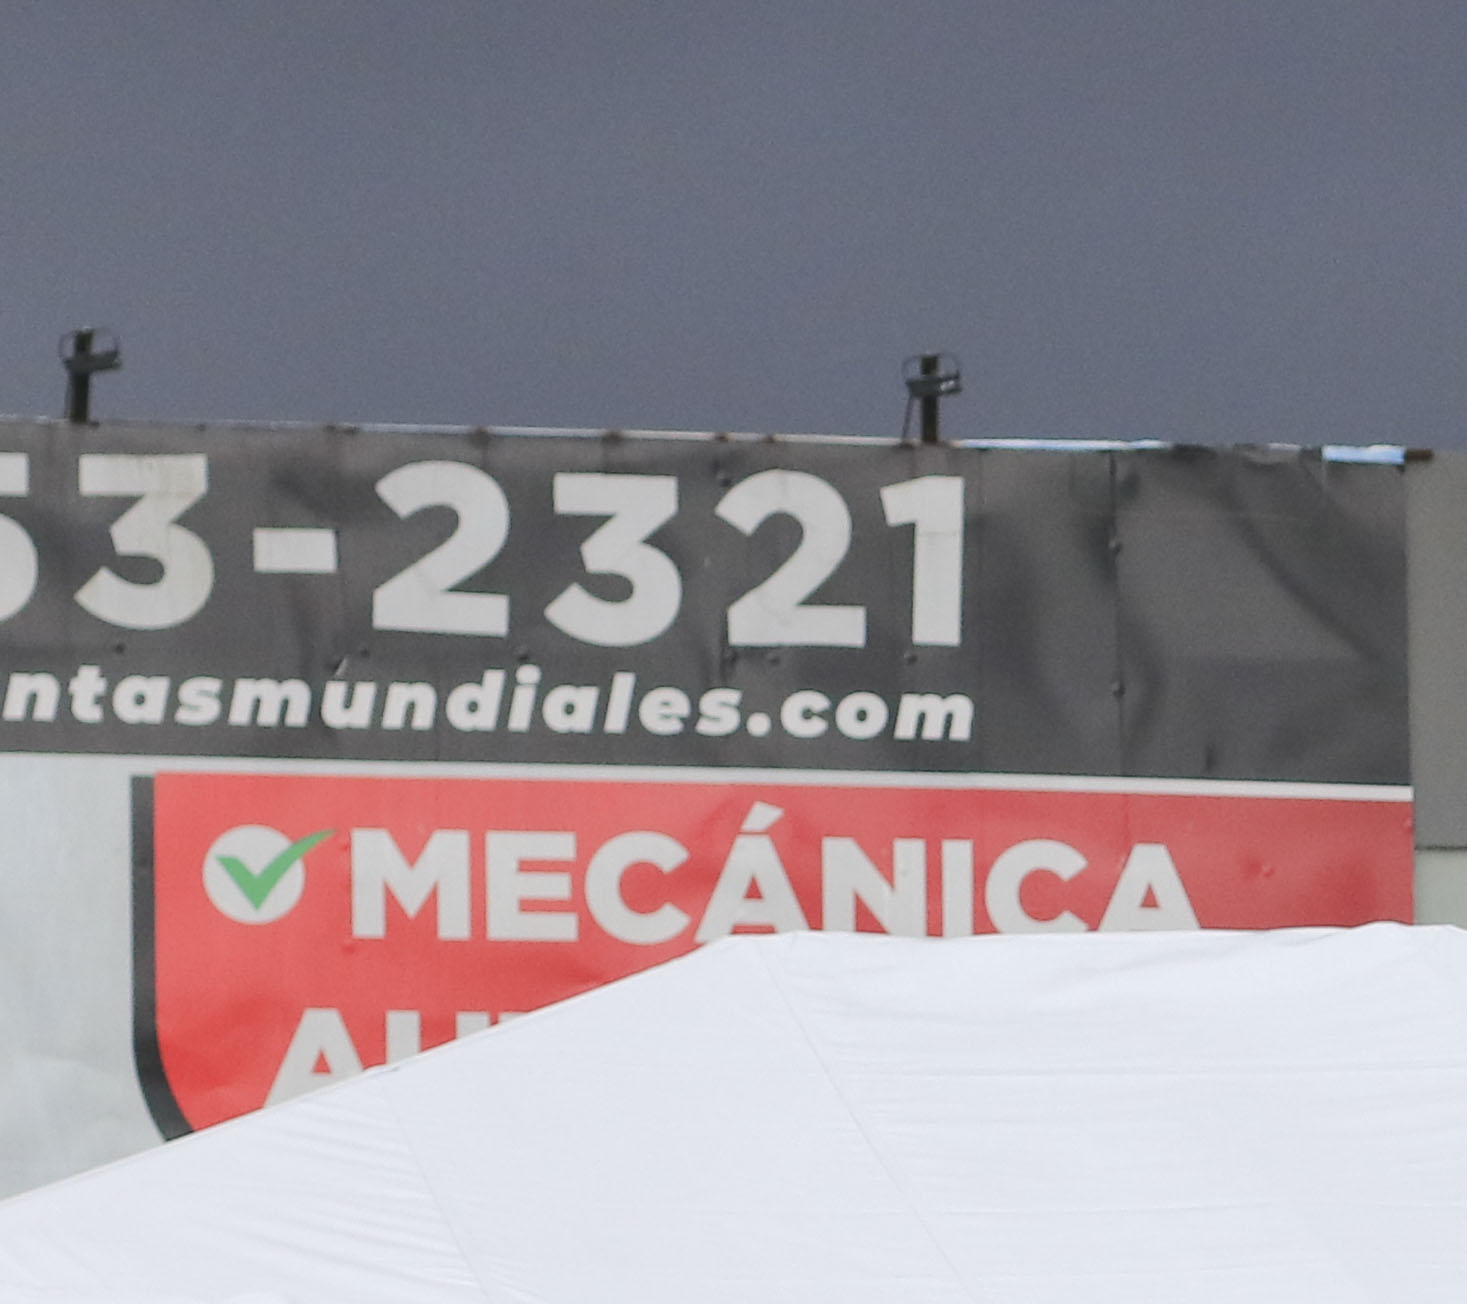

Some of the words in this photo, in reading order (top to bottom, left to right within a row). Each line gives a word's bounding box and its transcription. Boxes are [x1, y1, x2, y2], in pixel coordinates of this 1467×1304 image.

[0, 451, 964, 647] 3-2321
[3, 663, 974, 742] ntasmundiales.com
[350, 801, 1201, 943] MECÁNICA
